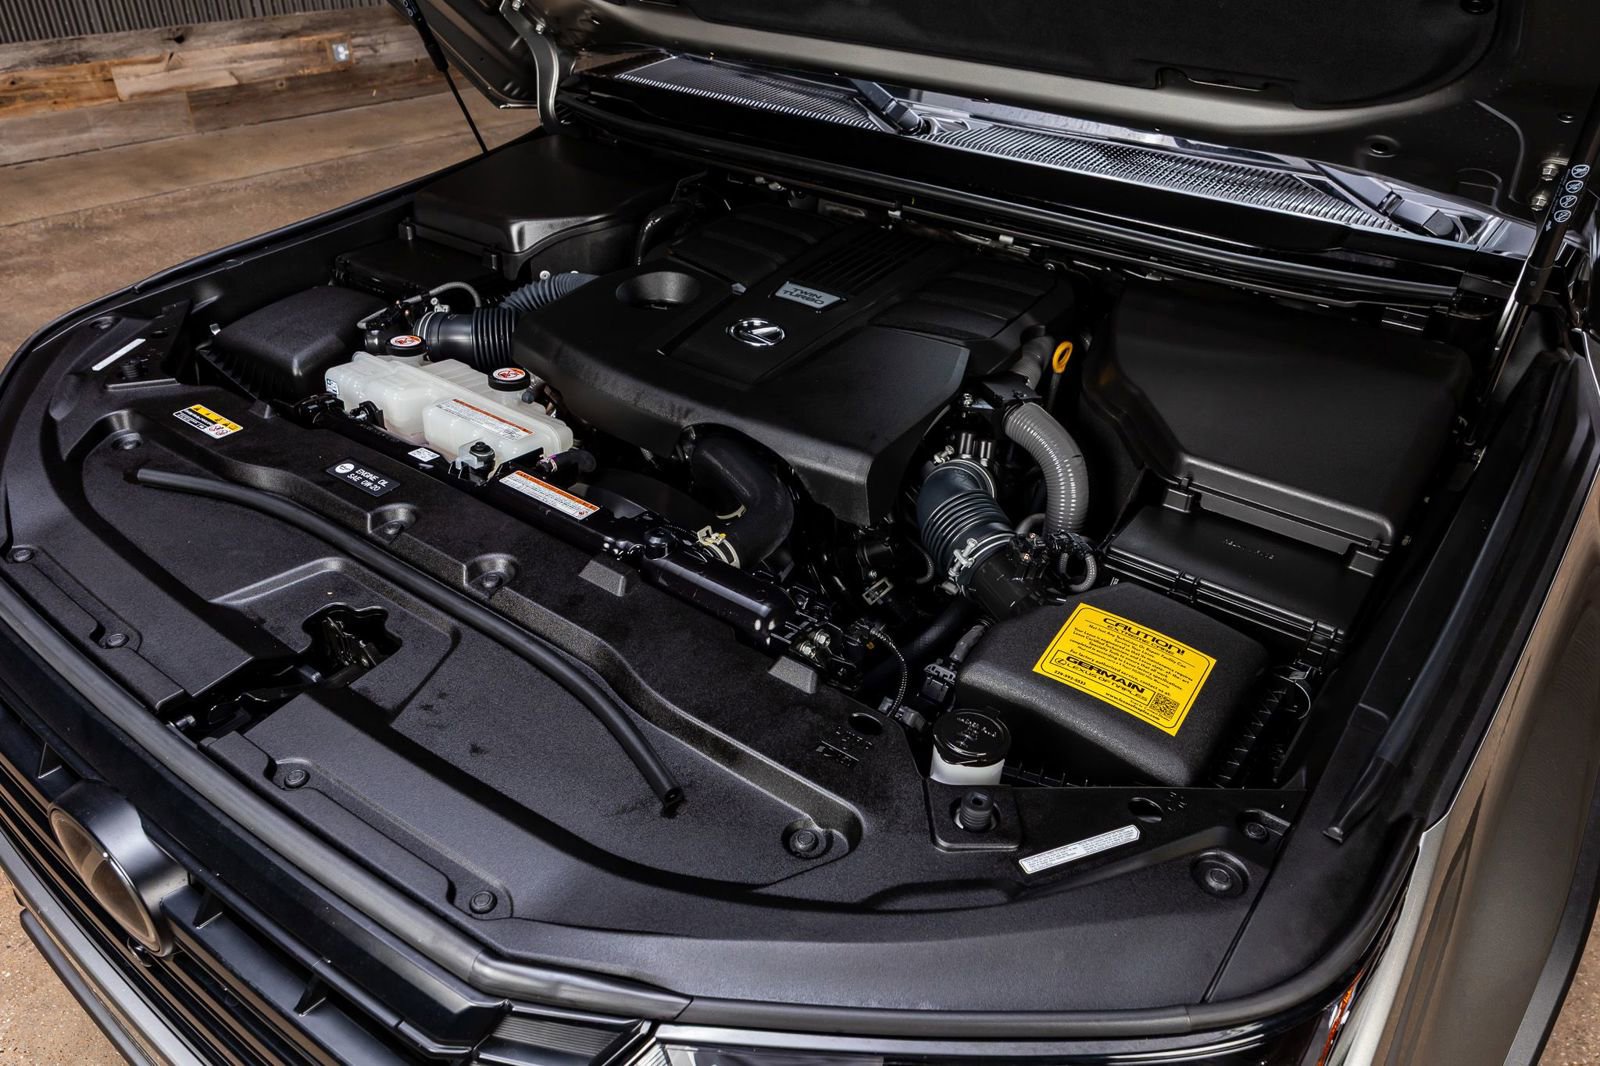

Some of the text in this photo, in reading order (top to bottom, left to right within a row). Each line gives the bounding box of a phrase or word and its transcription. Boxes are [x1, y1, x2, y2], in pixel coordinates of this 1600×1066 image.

[782, 289, 824, 304] TURBO
[793, 287, 822, 298] TWIN
[347, 473, 363, 482] SAE
[355, 468, 389, 487] ENGINE OIL
[1103, 618, 1185, 654] CAUTION!
[1107, 625, 1173, 654] EXTREME CARE
[1066, 656, 1144, 693] GERMAIN
[1067, 663, 1096, 678] LEXUS
[1111, 682, 1147, 701] NAPLES
